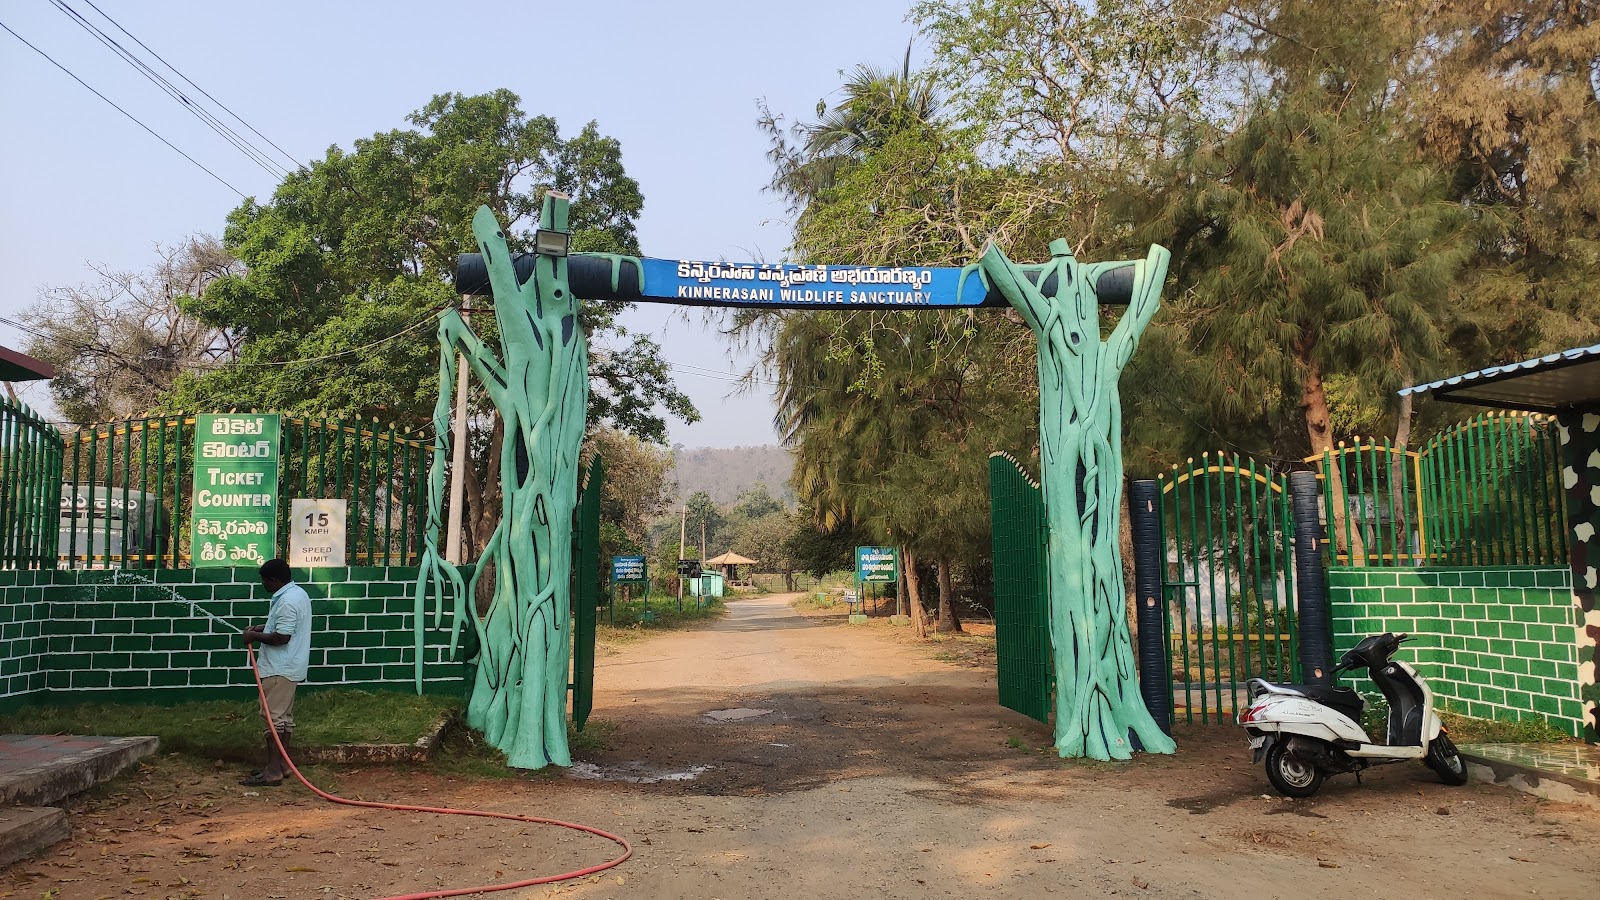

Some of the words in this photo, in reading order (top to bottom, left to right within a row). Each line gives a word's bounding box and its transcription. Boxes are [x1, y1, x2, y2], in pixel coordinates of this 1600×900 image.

[758, 264, 827, 288] వన్యప్రాణి
[831, 267, 932, 290] అభయారణ్యం
[678, 286, 773, 301] KINNERASANI
[780, 290, 843, 303] WILDLIFE
[850, 291, 931, 304] SANCTUARY
[212, 418, 265, 435] టికెట్
[202, 440, 270, 458] కౌంటర్
[207, 468, 264, 486] TICKET
[198, 490, 272, 507] COUNTER
[305, 513, 329, 527] 15
[197, 519, 268, 541] కిన్నెరసాని
[200, 542, 227, 561] డీర్
[230, 543, 266, 566] పార్క్
